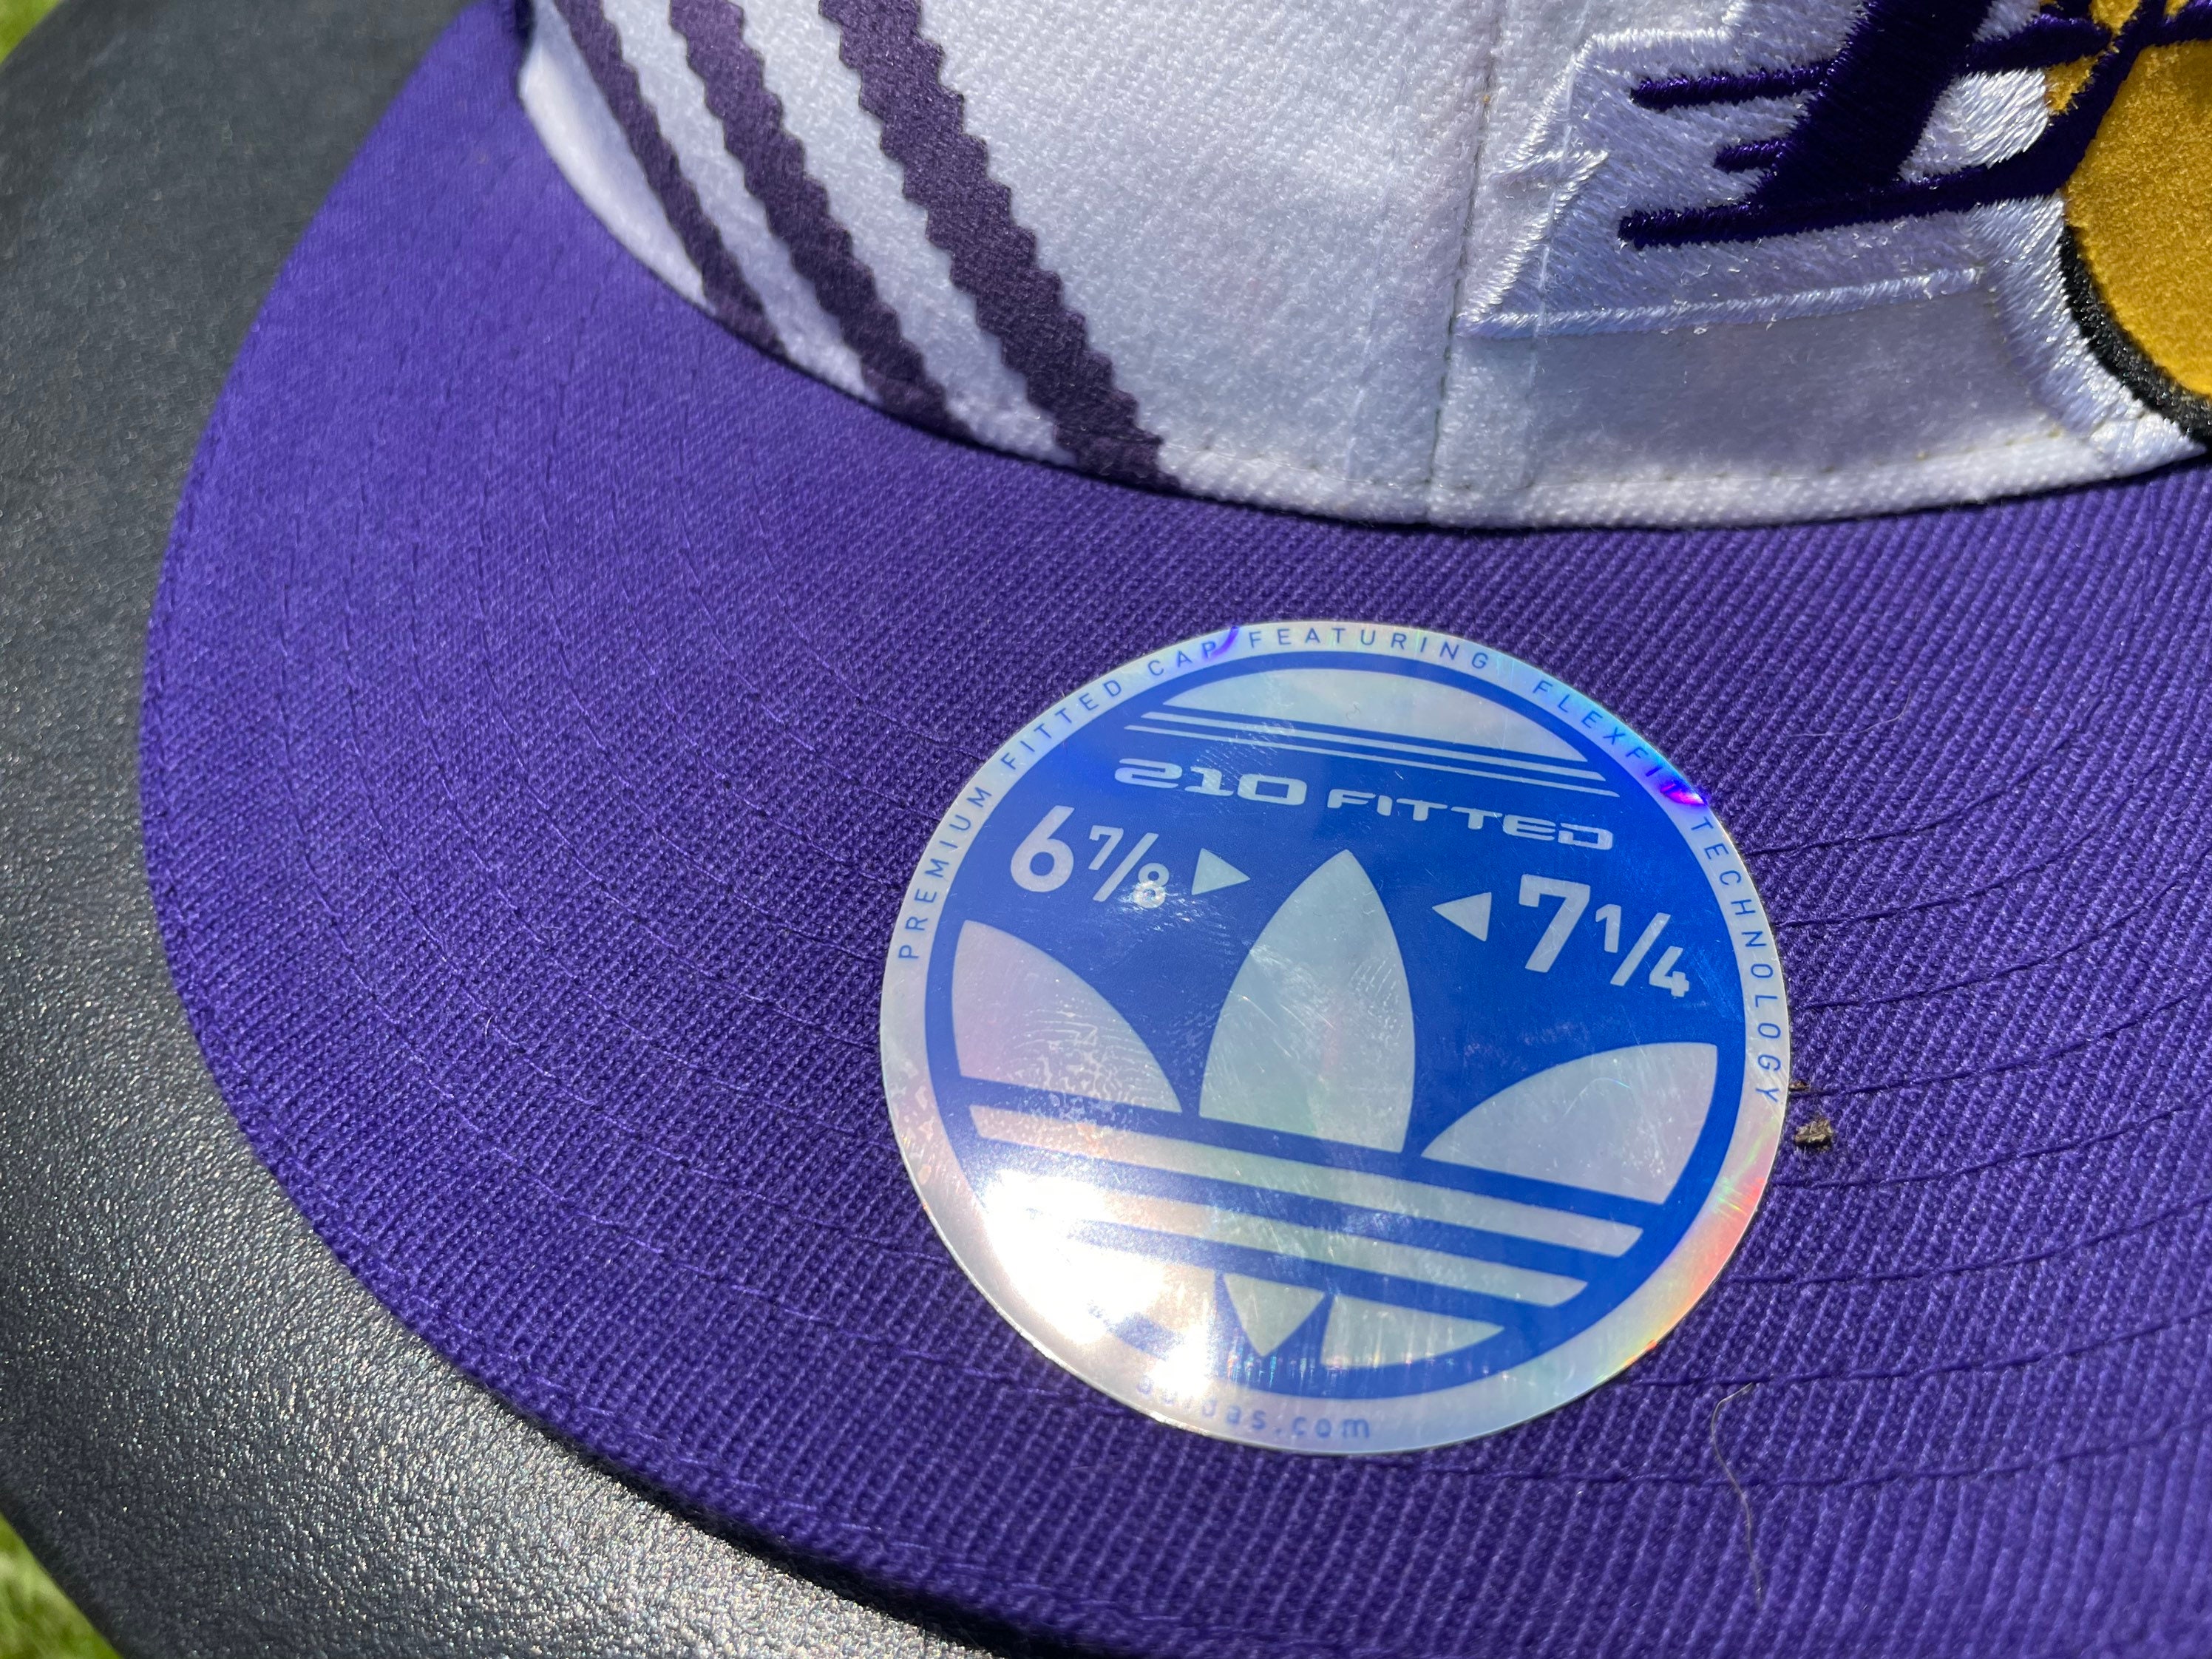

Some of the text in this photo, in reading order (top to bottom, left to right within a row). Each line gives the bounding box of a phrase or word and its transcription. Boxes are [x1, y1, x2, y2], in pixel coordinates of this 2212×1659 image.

[1113, 757, 1614, 851] 210 FITTED
[898, 785, 993, 960] PREMIUM
[1000, 678, 1123, 770] FITTED
[1147, 640, 1216, 677] CAP
[1248, 627, 1489, 669] FEATURING
[1691, 816, 1782, 1102] TECHNOLOGY
[1136, 1374, 1370, 1439] adas.com
